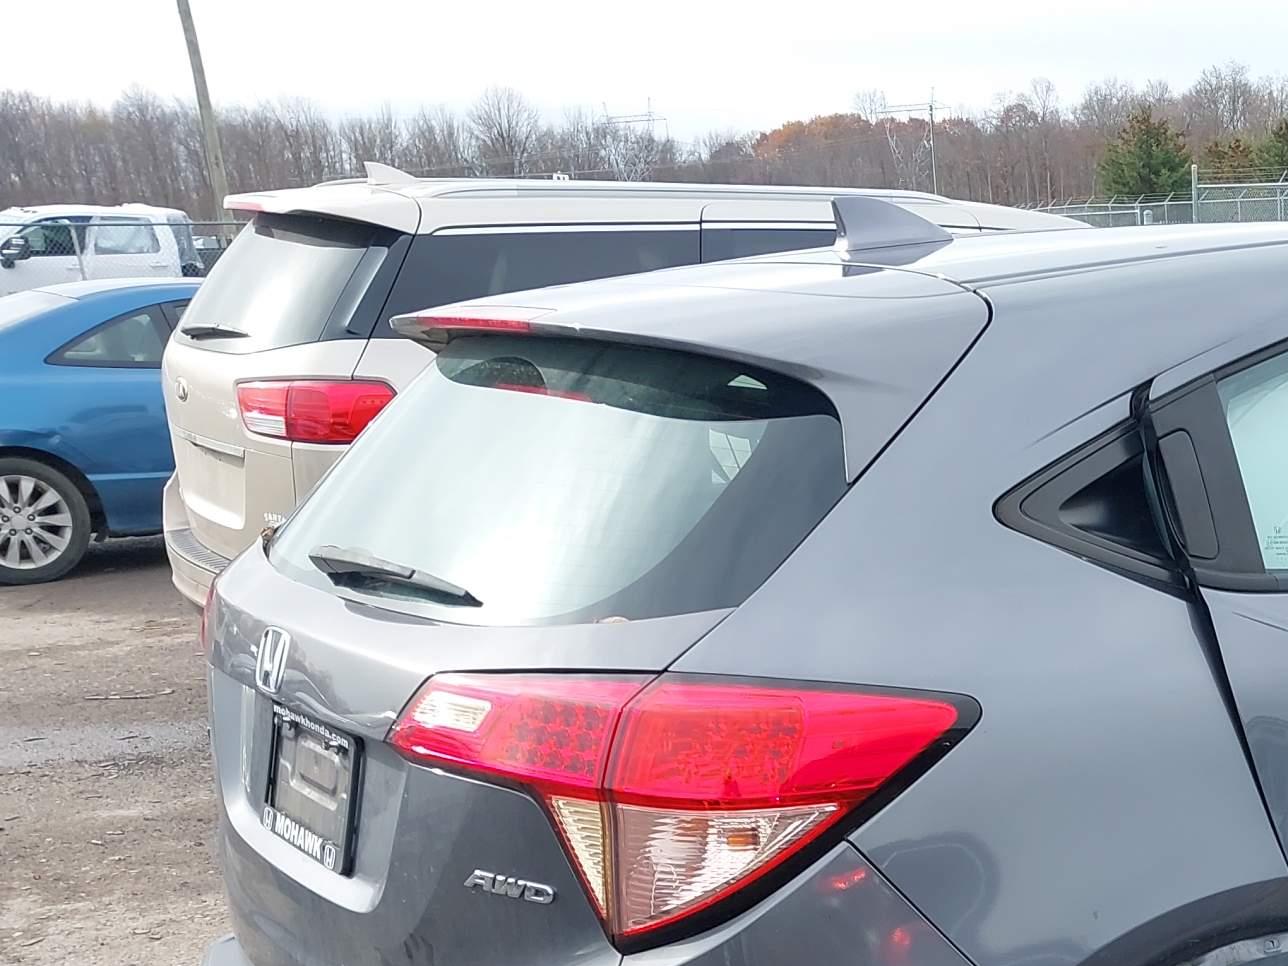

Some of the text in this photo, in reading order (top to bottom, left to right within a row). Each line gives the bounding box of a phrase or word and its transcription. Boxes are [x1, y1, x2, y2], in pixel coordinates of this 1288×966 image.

[273, 703, 350, 749] mohawkhonda.com
[274, 811, 323, 860] MOHAWK
[463, 869, 555, 904] AWD
